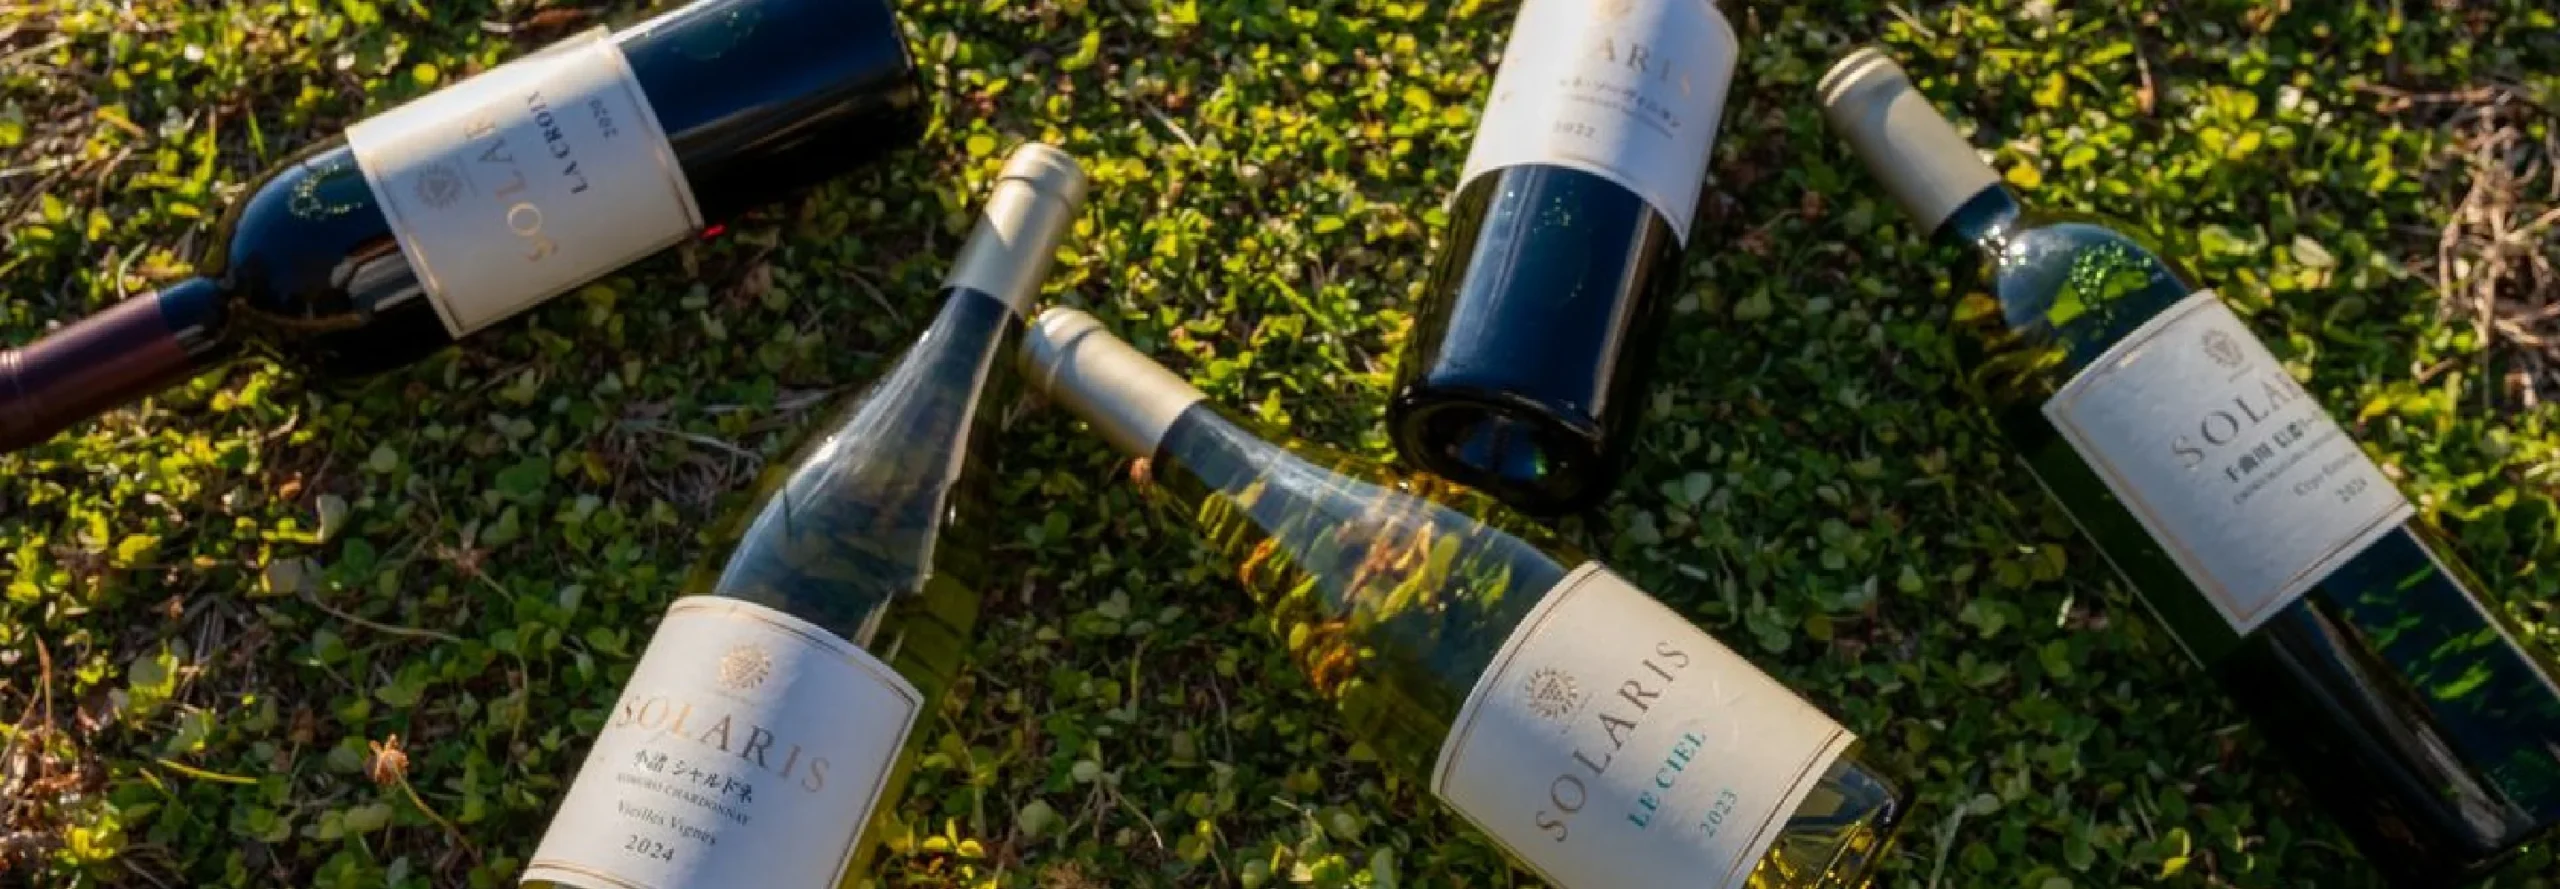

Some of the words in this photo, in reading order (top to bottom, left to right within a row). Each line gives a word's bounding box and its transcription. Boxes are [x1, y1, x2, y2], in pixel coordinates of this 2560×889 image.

[562, 160, 589, 194] LA
[616, 694, 831, 794] SOLARIS
[1534, 639, 1691, 843] SOLARIS
[1627, 789, 1662, 830] LE
[1654, 729, 1708, 791] CIEL
[663, 782, 752, 827] CHARDONNAY
[1699, 788, 1739, 838] 2023
[623, 833, 675, 863] 2024
[671, 814, 718, 847] Vignes
